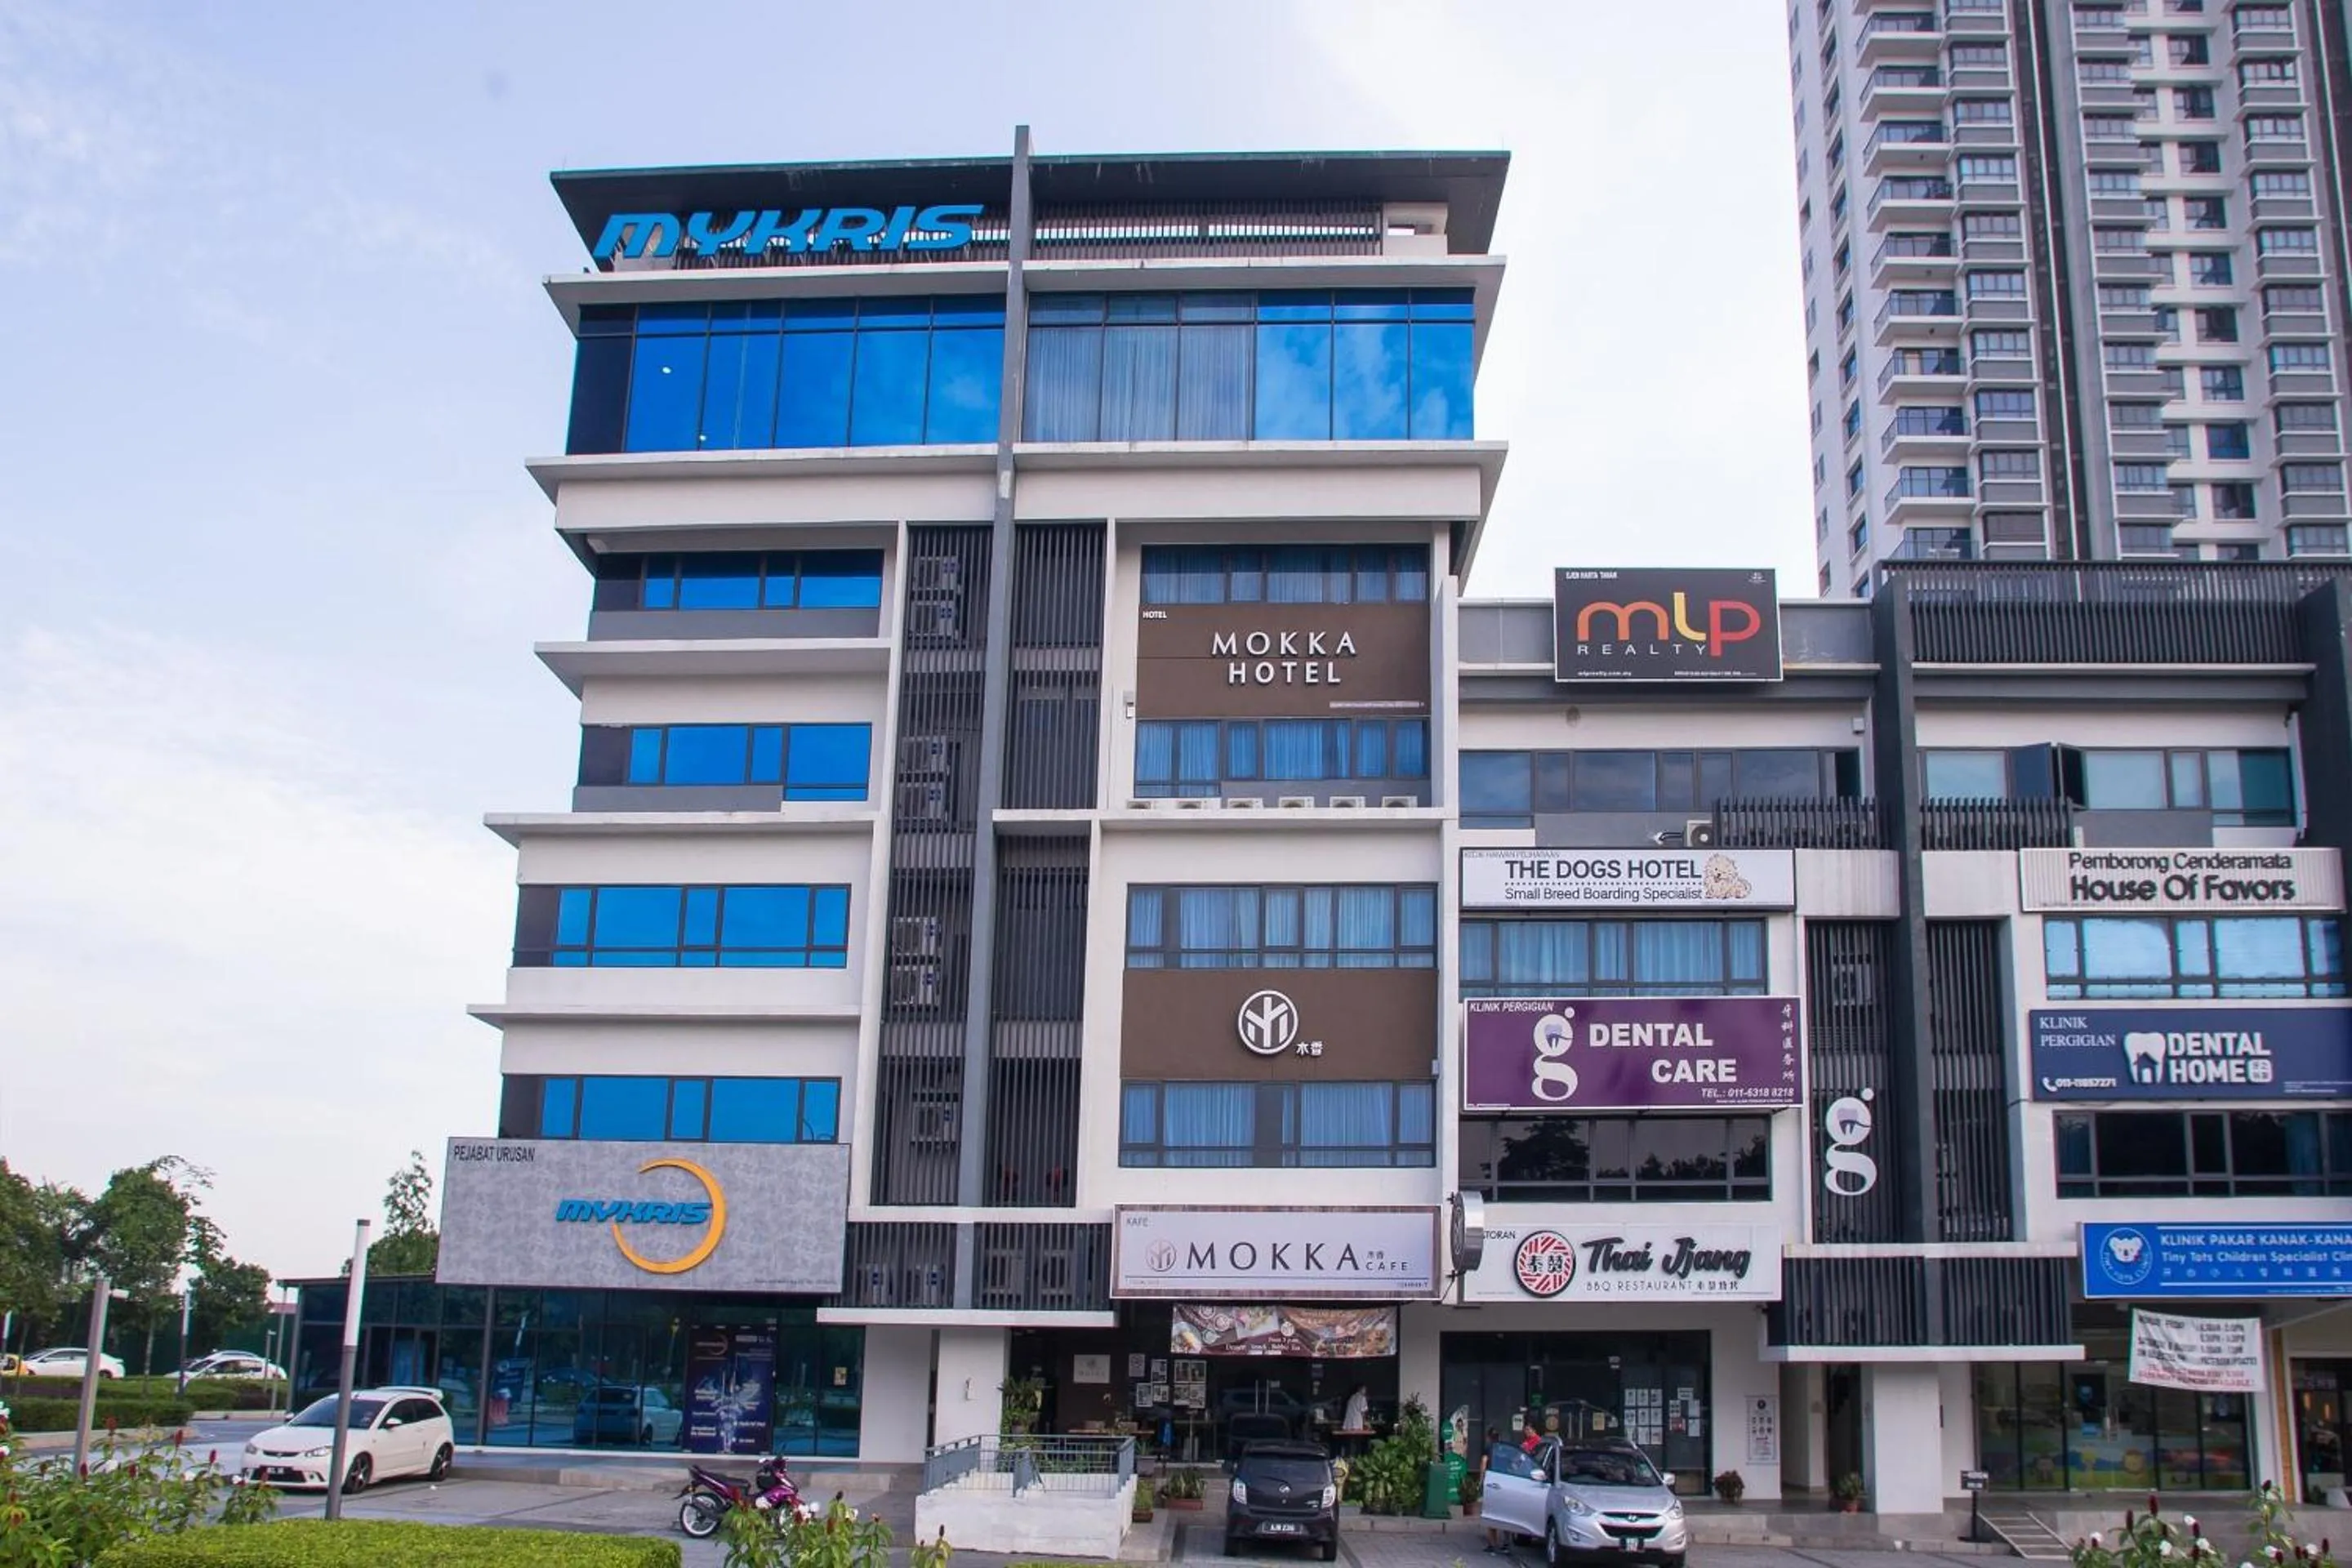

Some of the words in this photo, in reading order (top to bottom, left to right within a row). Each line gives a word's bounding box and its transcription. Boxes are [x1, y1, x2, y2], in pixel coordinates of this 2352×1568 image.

[1143, 611, 1167, 619] HOTEL
[1212, 631, 1356, 657] MOKKA
[1577, 644, 1706, 655] REALTY
[1228, 662, 1343, 685] HOTEL
[1505, 860, 1550, 879] THE
[1557, 860, 1621, 879] DOGS
[1628, 860, 1702, 879] HOTEL
[2069, 853, 2170, 874] Pemborong
[2173, 853, 2292, 870] Cenderamata
[1505, 888, 1540, 899] Small
[1544, 888, 1579, 899] Breed
[1584, 888, 1639, 902] Boarding
[1643, 888, 1703, 902] Specialist
[2070, 877, 2157, 901] House
[2163, 875, 2199, 901] Of
[2203, 876, 2296, 901] Favors
[1470, 1002, 1499, 1012] KLINIK
[1503, 1001, 1555, 1012] PERGIGIAN
[2039, 1017, 2087, 1029] KLINIK
[1589, 1023, 1713, 1047] DENTAL
[2041, 1034, 2116, 1046] PERGIGIAN
[2167, 1032, 2271, 1056] DENTAL
[1651, 1058, 1737, 1083] CARE
[2170, 1060, 2246, 1083] HOME
[453, 1146, 495, 1162] PEJABAT
[497, 1147, 535, 1162] URUSAN
[2160, 1234, 2206, 1246] KLINIK
[2210, 1234, 2256, 1246] PAKAR
[1187, 1241, 1360, 1272] MOKKA
[1581, 1236, 1654, 1273] Thai
[2163, 1251, 2186, 1264] Tiny
[2190, 1252, 2213, 1262] Tots
[2217, 1251, 2267, 1262] Children
[2270, 1251, 2328, 1263] Specialist
[1365, 1262, 1409, 1271] CAFE
[1586, 1281, 1610, 1292] BBQ
[1618, 1281, 1692, 1291] RESTAURANT
